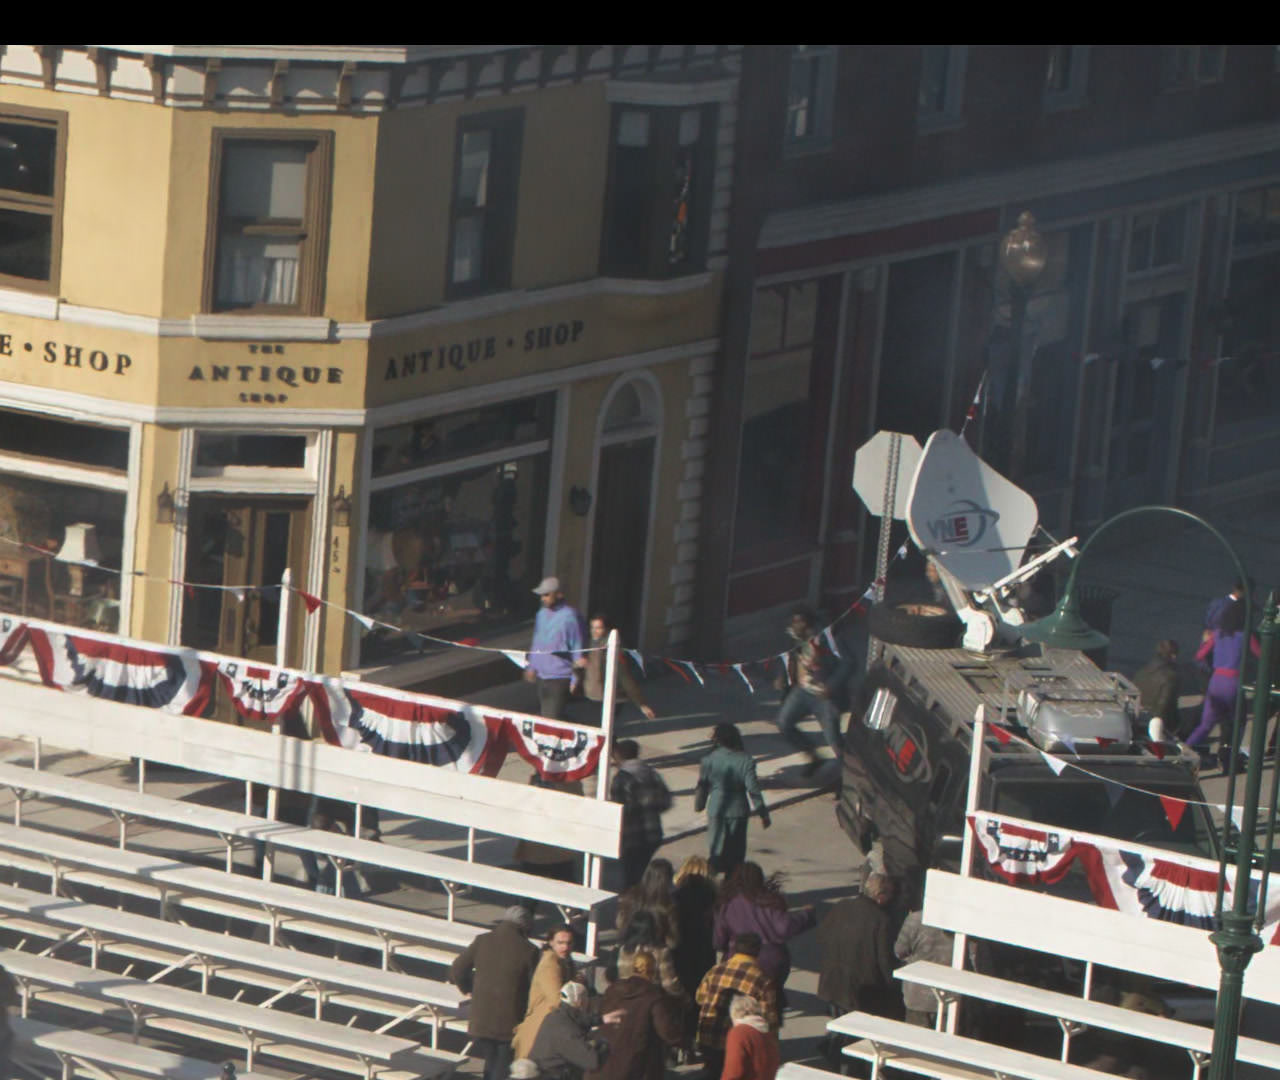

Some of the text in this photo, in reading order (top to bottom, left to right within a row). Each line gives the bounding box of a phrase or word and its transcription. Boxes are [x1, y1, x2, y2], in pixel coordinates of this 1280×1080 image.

[43, 341, 133, 376] SHOP
[248, 344, 285, 354] THE
[384, 320, 584, 381] ANTIQUE SHOP
[189, 365, 344, 388] ANTIQUE
[239, 392, 289, 403] SHOP
